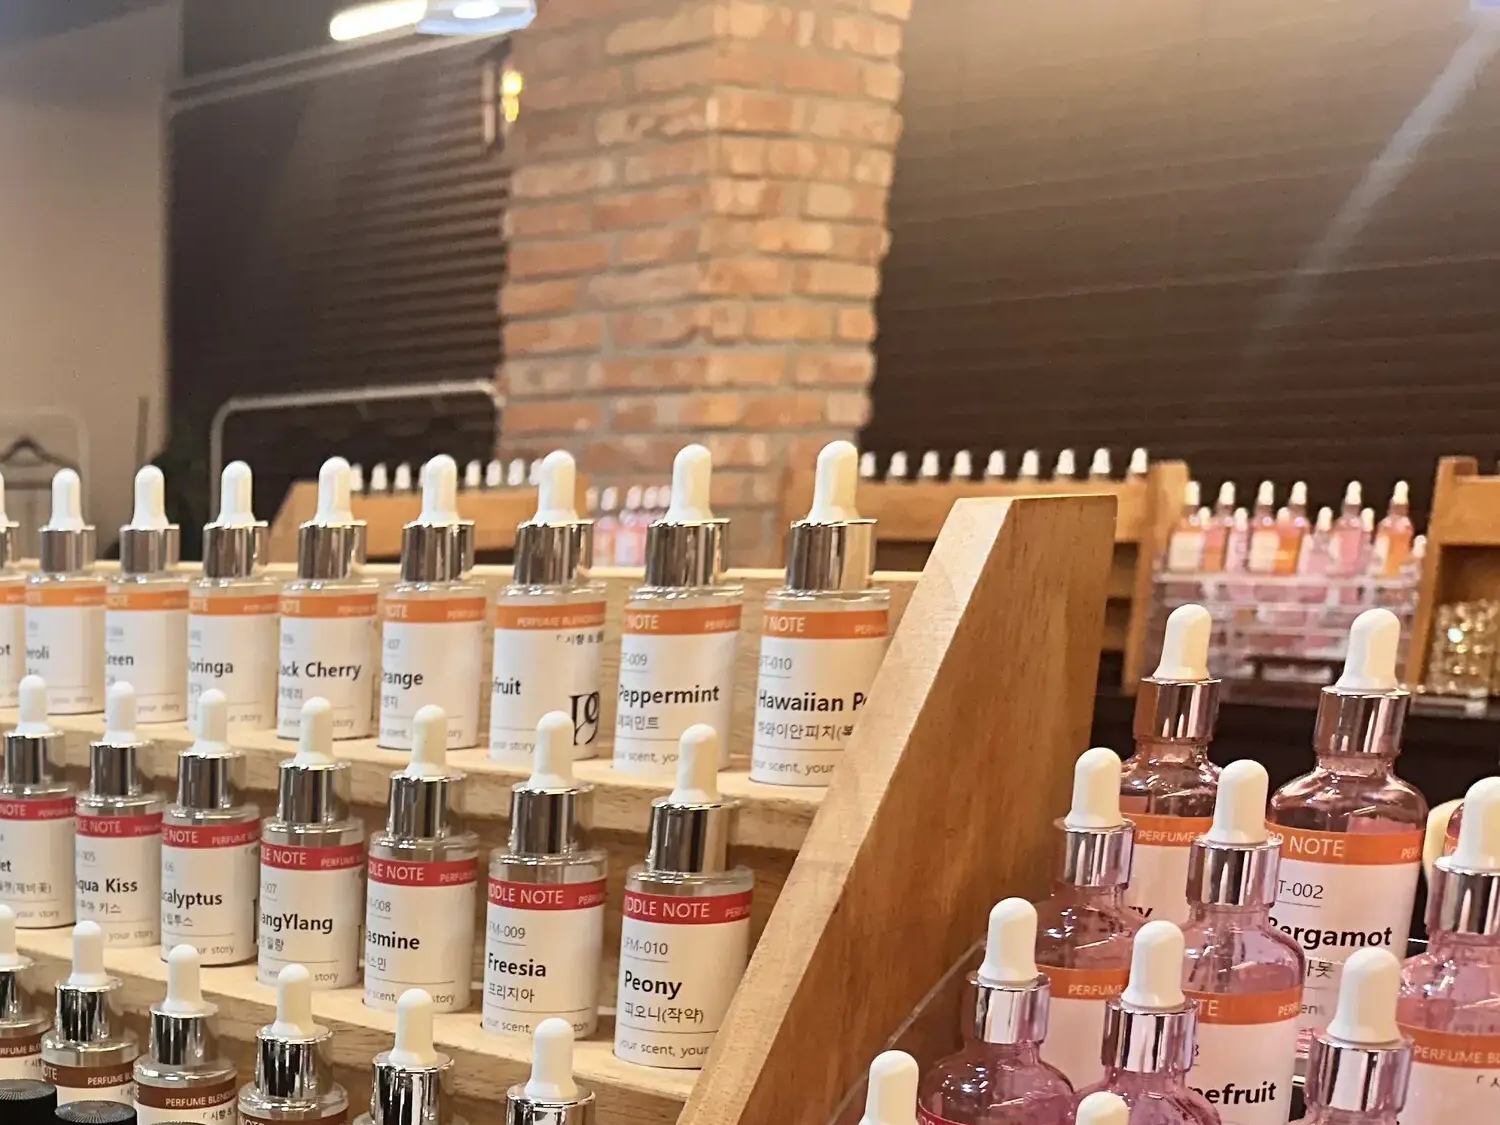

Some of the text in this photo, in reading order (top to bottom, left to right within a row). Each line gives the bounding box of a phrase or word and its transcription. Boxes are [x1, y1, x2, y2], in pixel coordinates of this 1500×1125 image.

[770, 616, 806, 633] NOTE
[106, 653, 134, 666] reen
[189, 659, 234, 678] oringa
[304, 661, 362, 681] Cherry
[383, 672, 424, 689] range
[758, 691, 844, 713] Hawaiian
[804, 763, 836, 776] your
[90, 820, 122, 834] NOTE
[169, 829, 198, 844] NOTE
[1289, 834, 1345, 857] NOTE
[271, 849, 307, 866] NOTE
[386, 866, 425, 882] NOTE
[78, 877, 138, 894] qua Kiss
[1278, 879, 1324, 900] T-002
[162, 888, 223, 909] calyptus
[520, 889, 565, 905] NOTE
[662, 901, 711, 918] NOTE
[262, 912, 334, 935] angYlang
[367, 930, 421, 950] asmine
[488, 952, 547, 978] Freesia
[314, 972, 339, 983] story
[624, 969, 683, 1000] Peony
[501, 1019, 533, 1035] scent,
[640, 1041, 677, 1057] scent,
[1413, 1044, 1484, 1064] PERFUME
[87, 1074, 125, 1086] PERFUME
[1187, 1080, 1277, 1105] efruit
[165, 1096, 207, 1107] PERFUME
